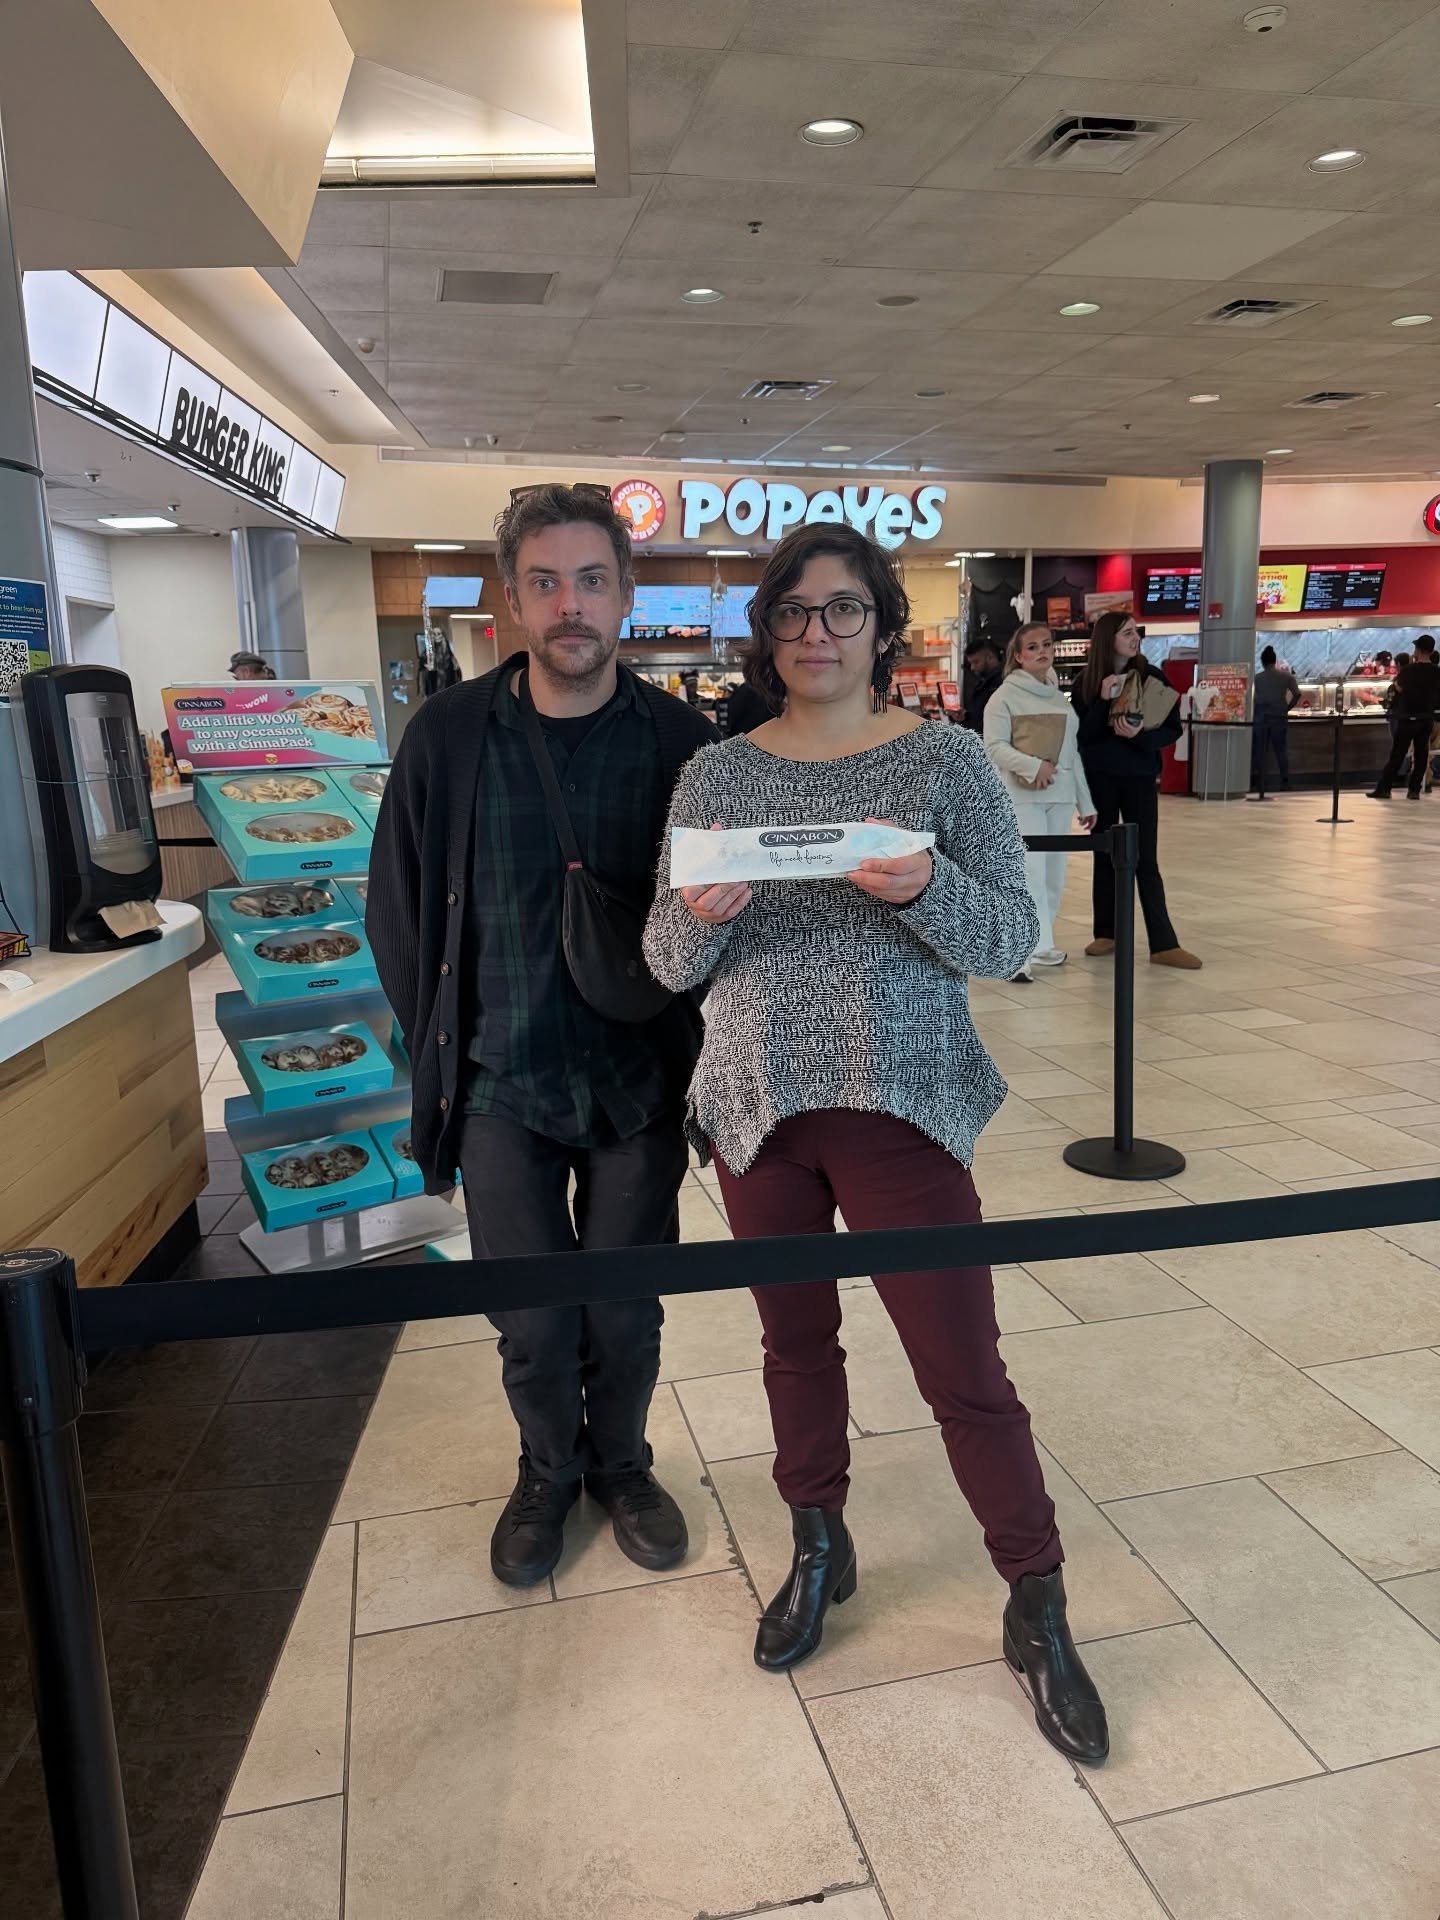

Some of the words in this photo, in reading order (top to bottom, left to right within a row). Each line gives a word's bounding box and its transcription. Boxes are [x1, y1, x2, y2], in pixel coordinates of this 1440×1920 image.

[171, 387, 249, 476] BURGER
[248, 439, 286, 497] KING
[626, 495, 652, 526] P
[176, 699, 224, 709] CINNABON
[181, 716, 211, 728] Add
[213, 718, 222, 727] a
[223, 715, 256, 727] little
[257, 713, 297, 725] WOW
[197, 730, 211, 740] to
[213, 729, 239, 741] any
[242, 725, 304, 738] occasion
[192, 740, 226, 752] with
[227, 742, 237, 751] a
[238, 737, 314, 750] CinnaPack
[764, 831, 837, 844] CINNABON
